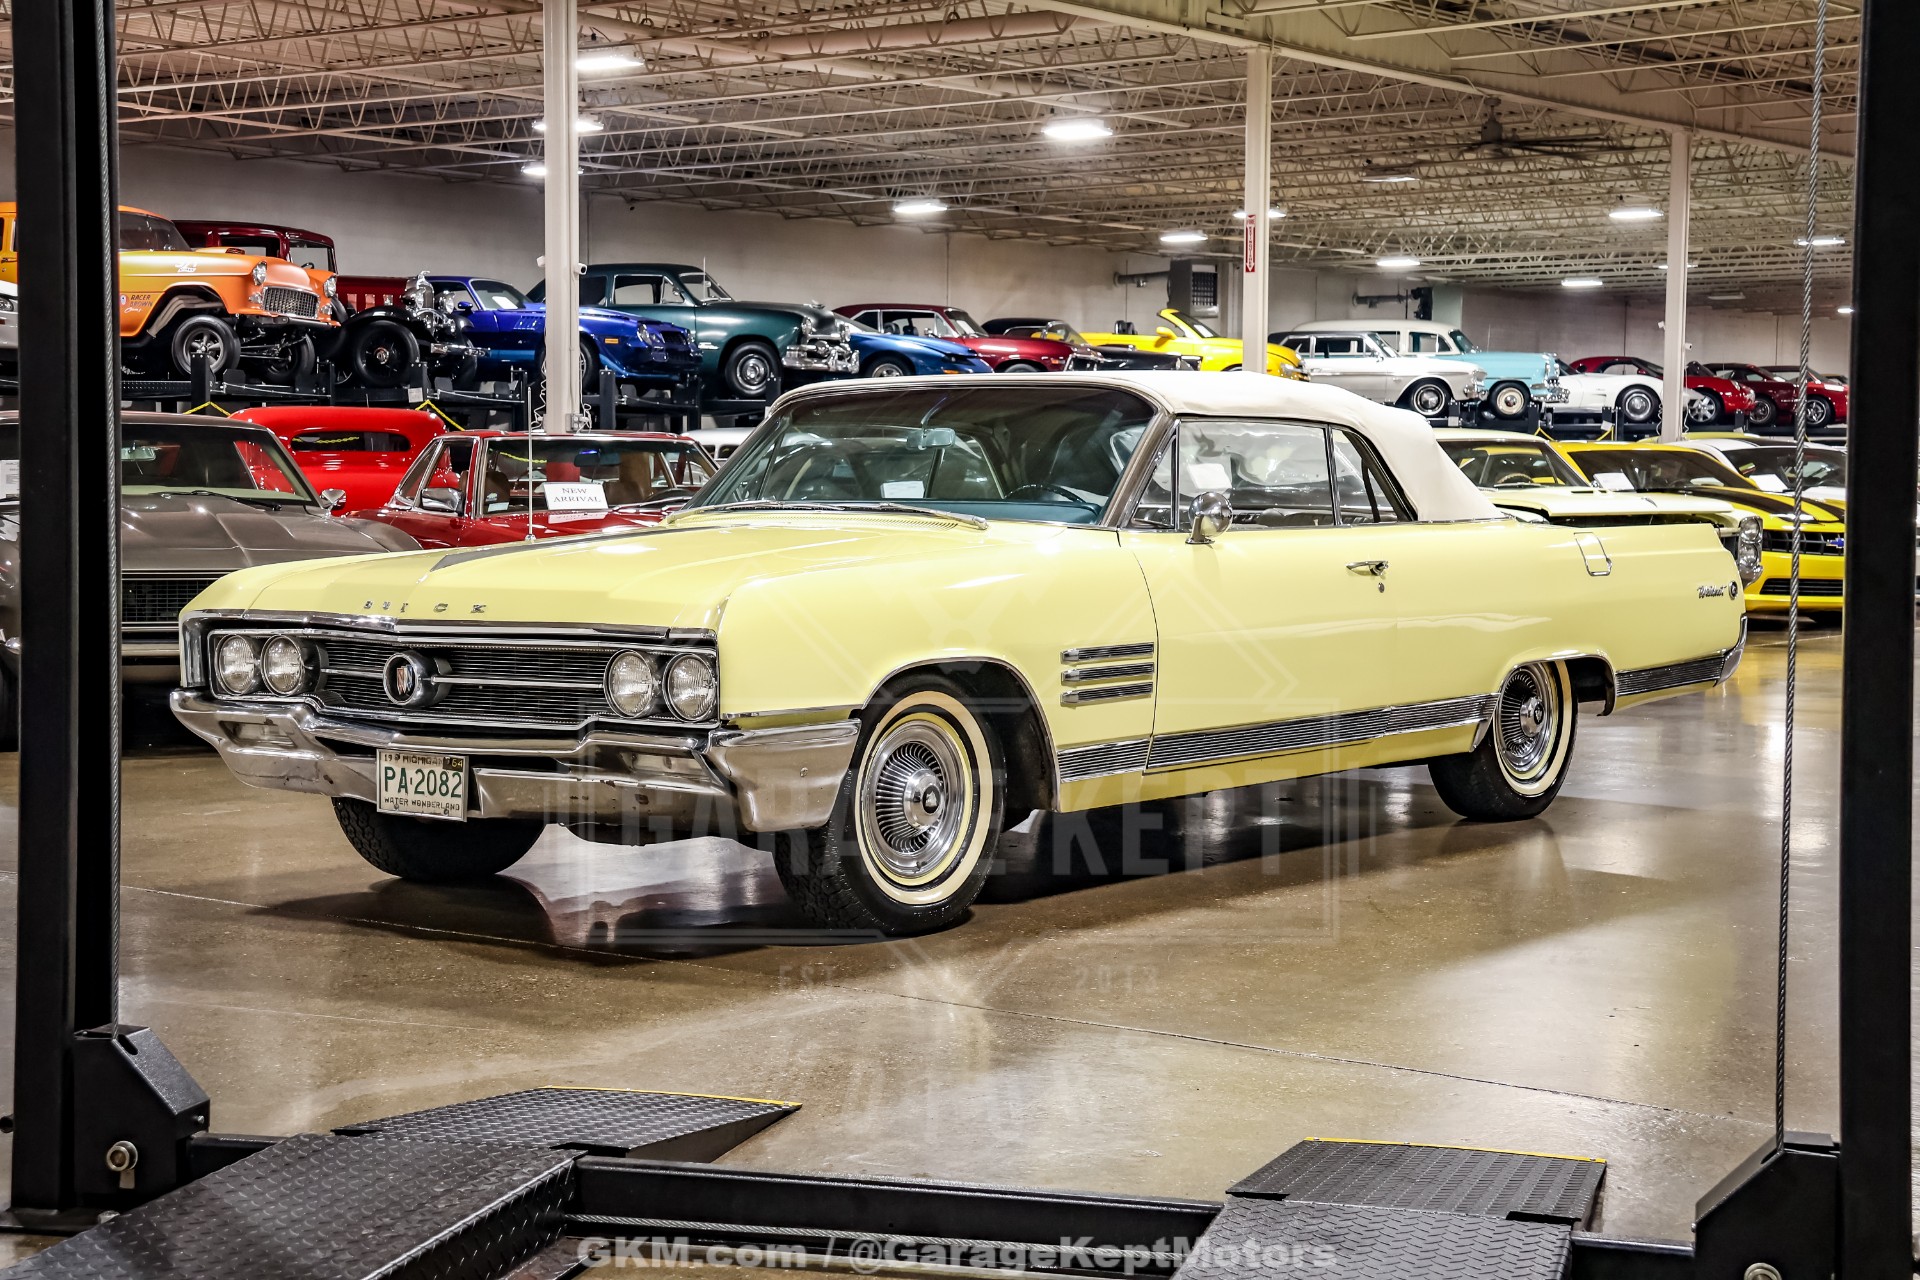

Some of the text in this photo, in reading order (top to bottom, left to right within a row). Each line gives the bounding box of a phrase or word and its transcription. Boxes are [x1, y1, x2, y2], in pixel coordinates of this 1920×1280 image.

[363, 600, 487, 614] BUICK
[451, 758, 463, 768] 64
[384, 797, 460, 811] WATER WONDERLAND
